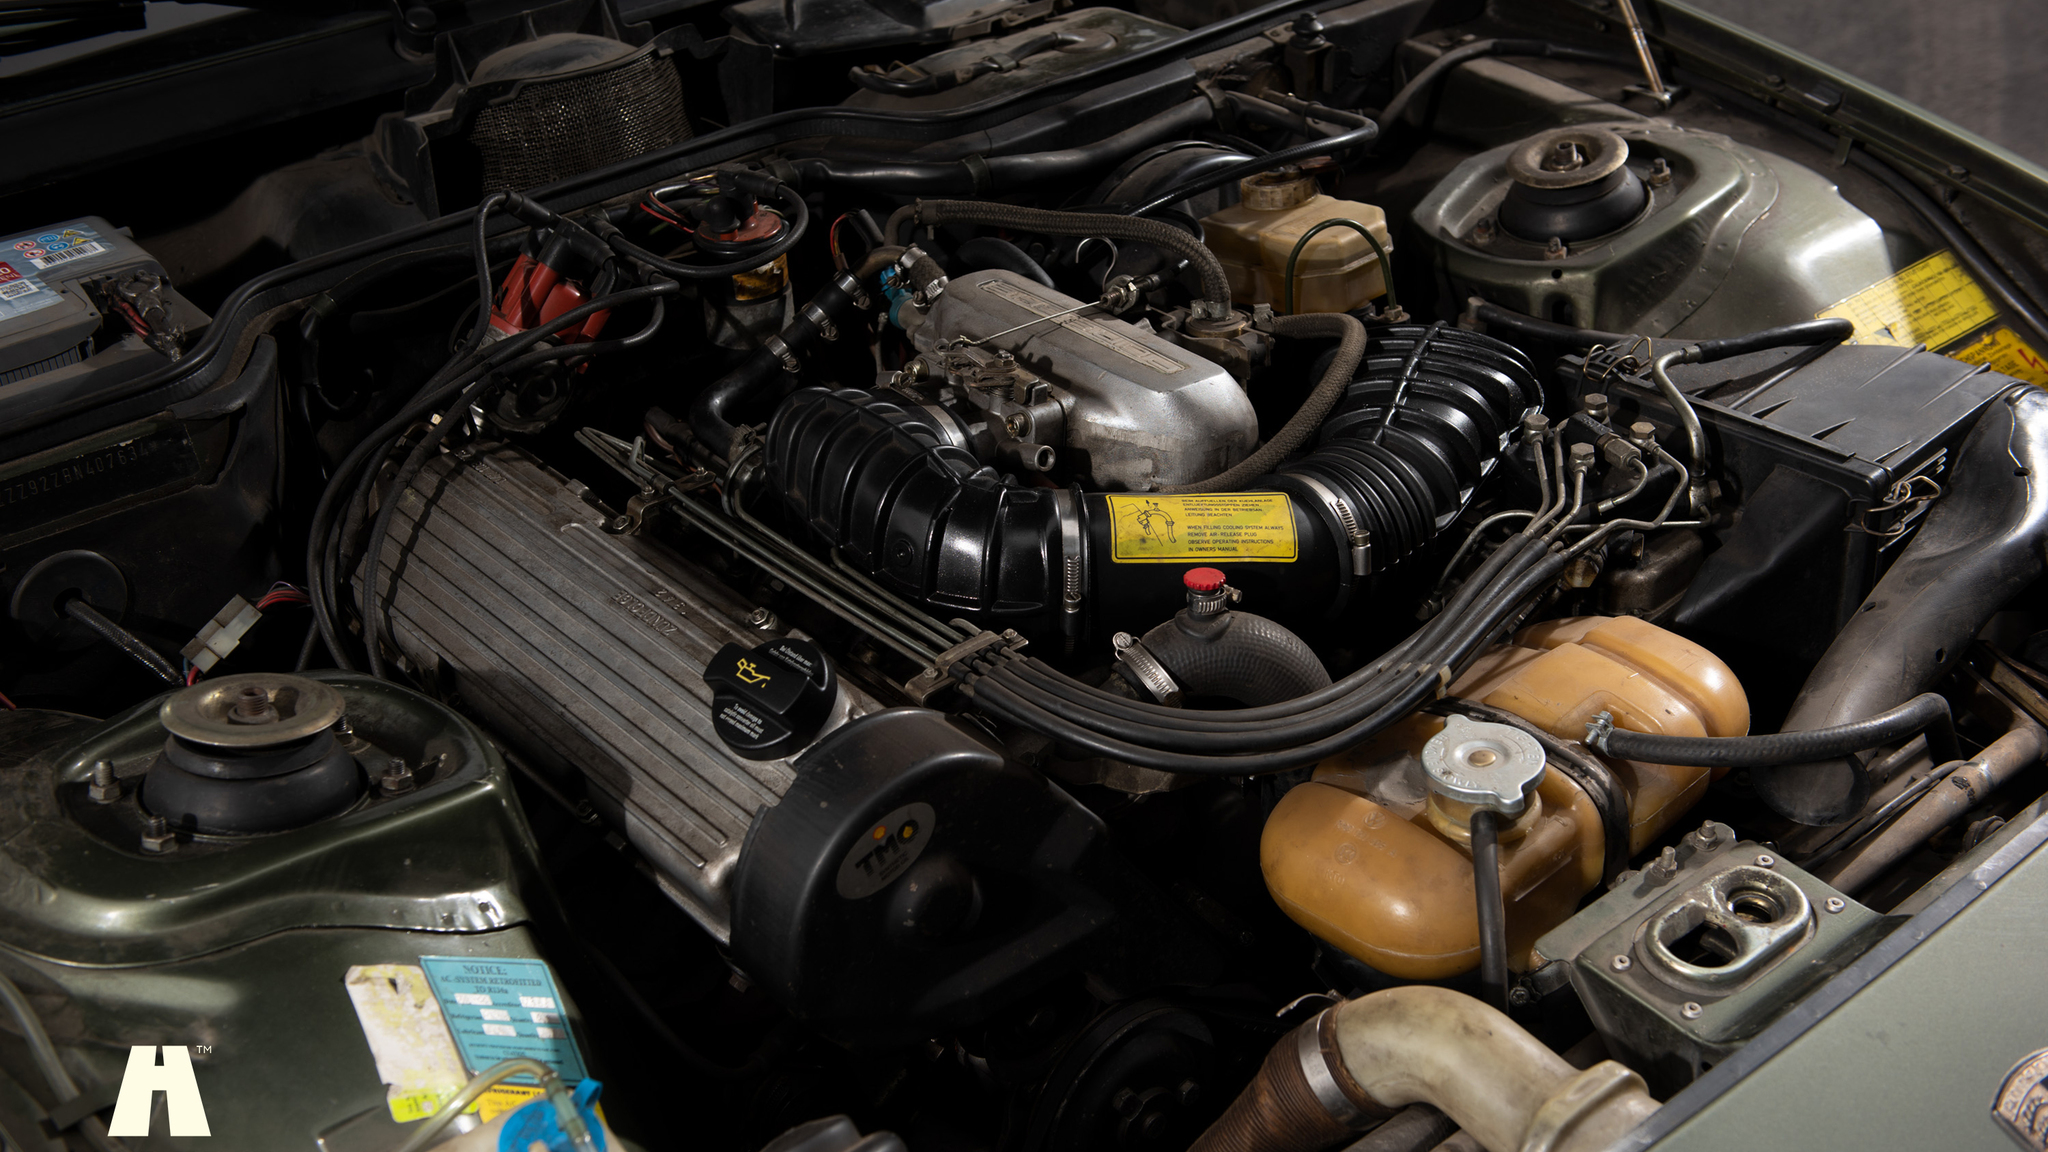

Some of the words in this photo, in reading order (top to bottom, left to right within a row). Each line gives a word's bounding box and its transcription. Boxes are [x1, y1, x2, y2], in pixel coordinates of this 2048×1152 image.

[855, 820, 919, 877] TMO
[462, 965, 508, 976] NOTICE:
[489, 977, 542, 986] RETROFITTED
